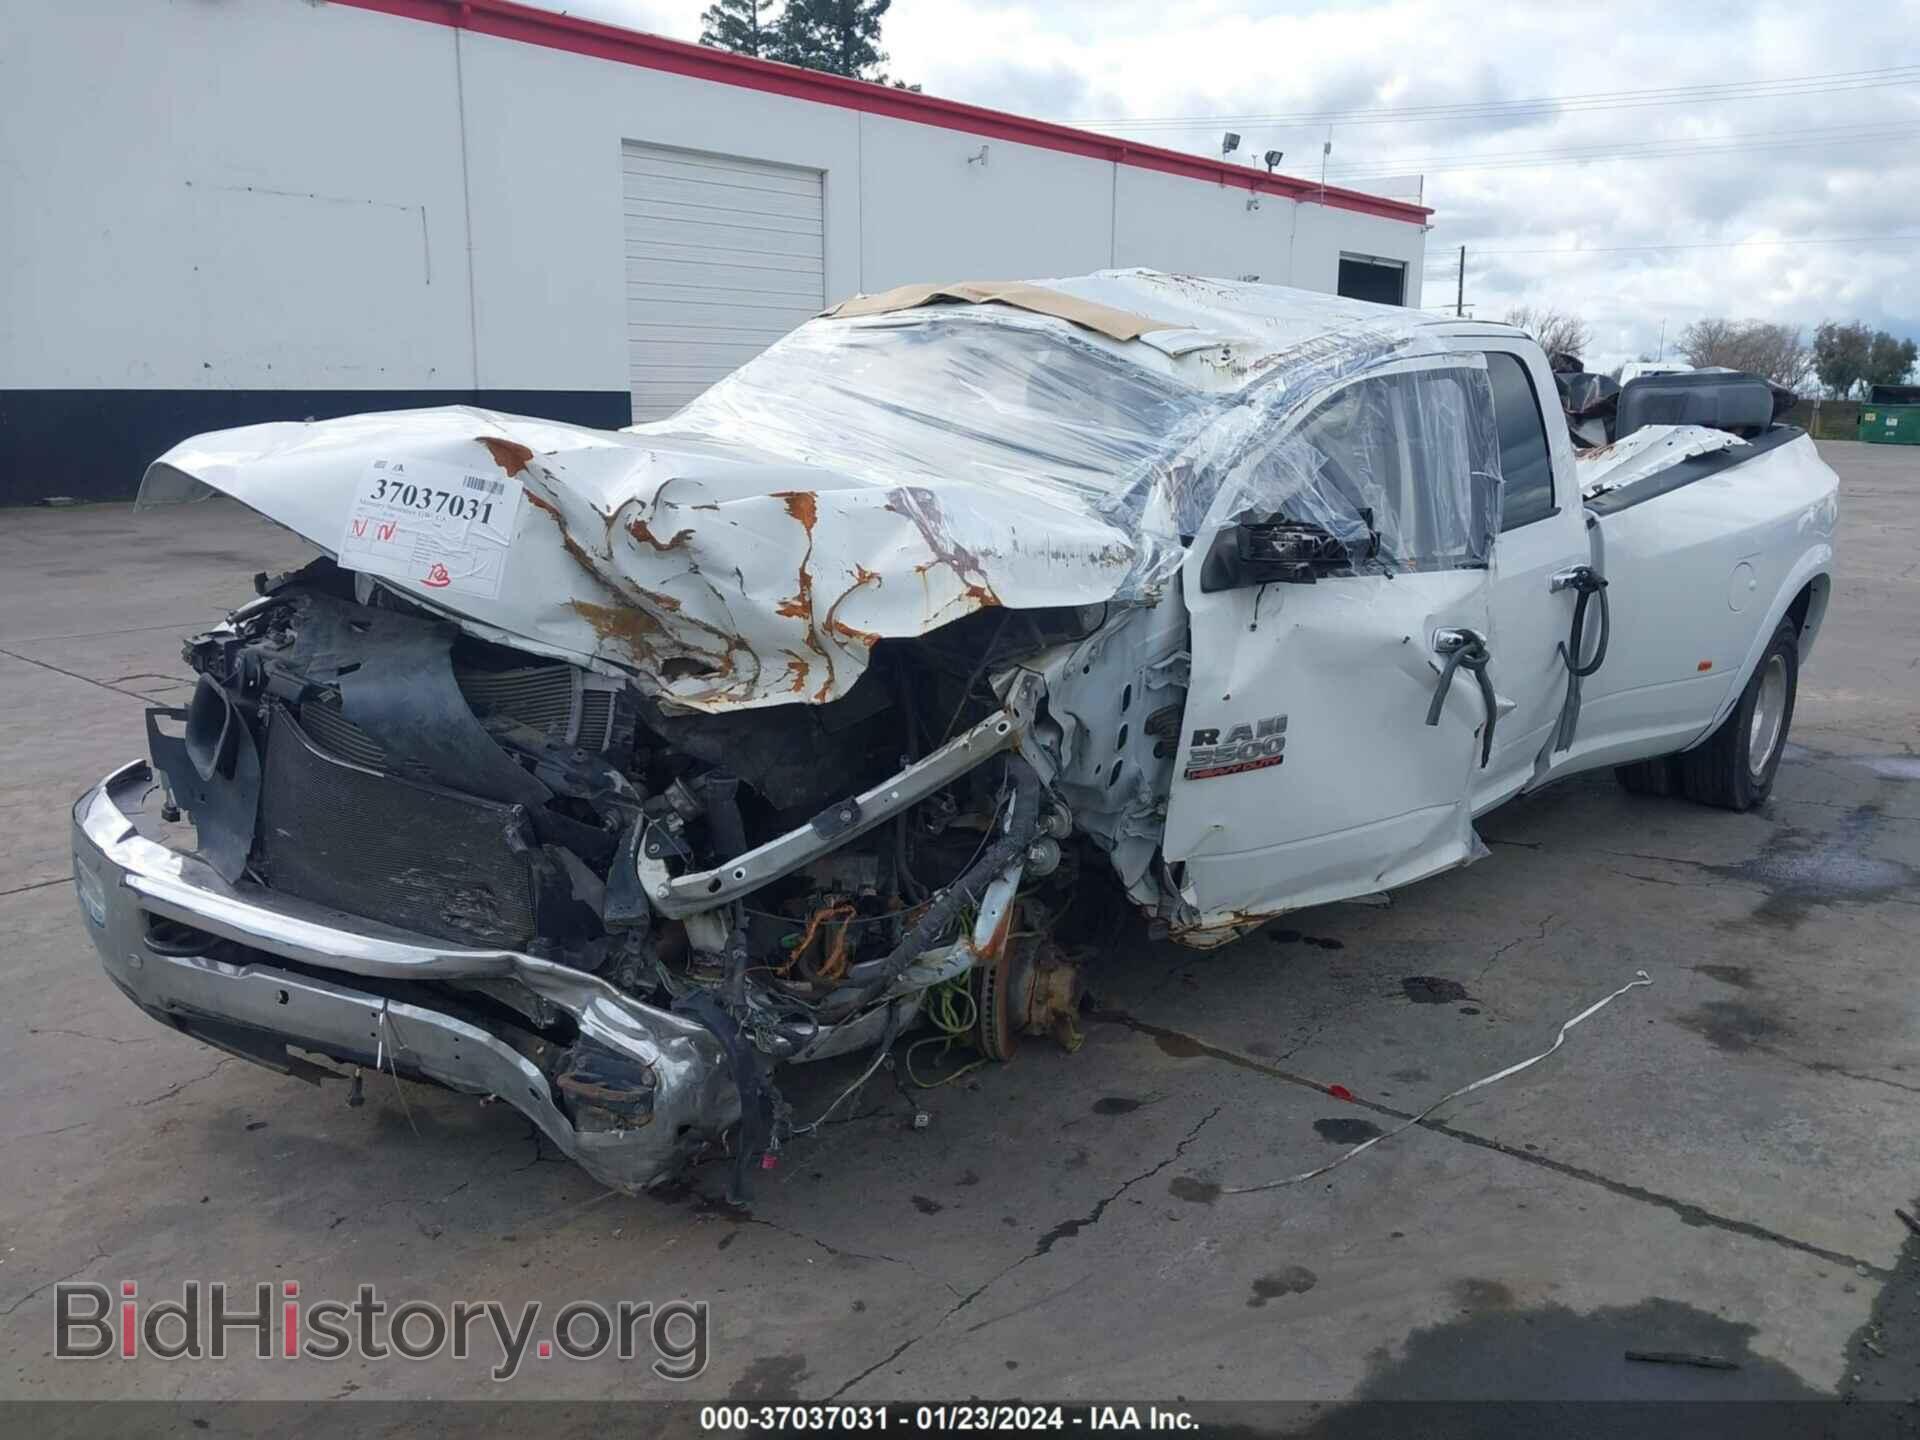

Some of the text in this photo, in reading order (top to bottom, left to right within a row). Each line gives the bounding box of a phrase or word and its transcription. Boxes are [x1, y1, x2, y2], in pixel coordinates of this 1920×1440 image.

[370, 479, 493, 524] 37037031
[1190, 714, 1288, 747] RAM
[1186, 735, 1286, 767] 3500
